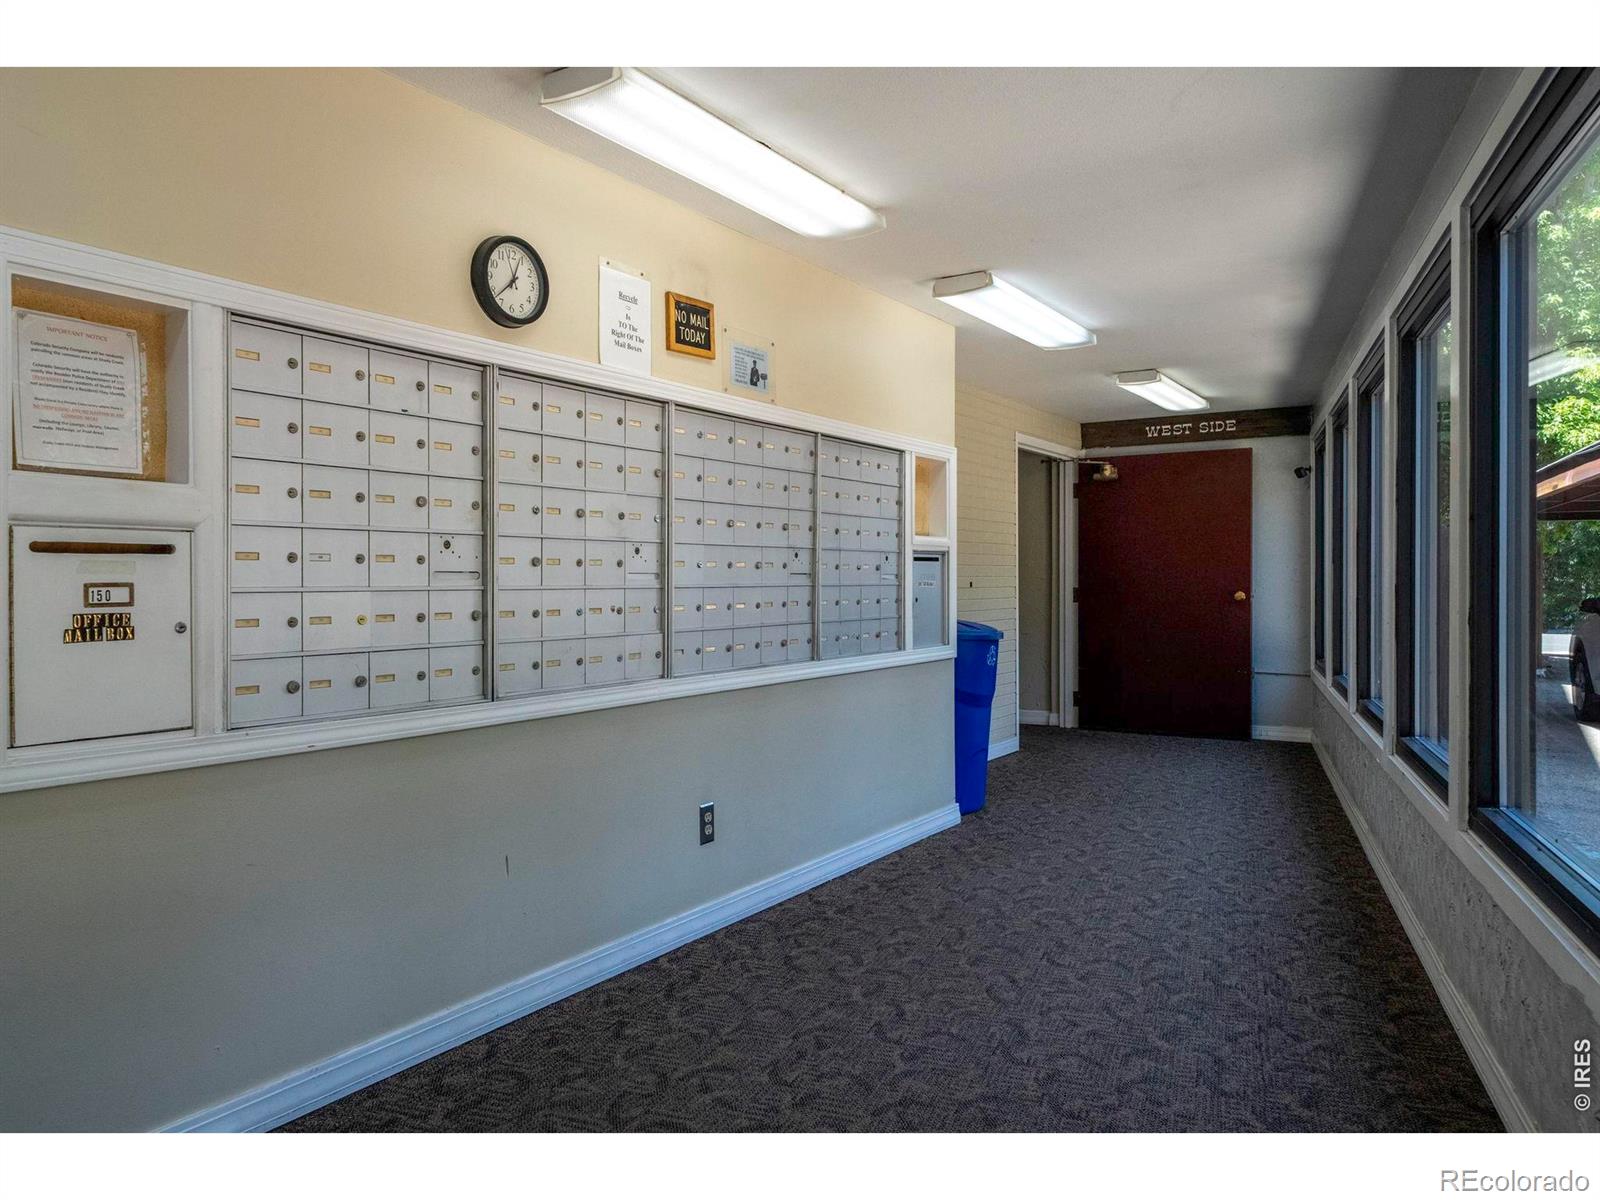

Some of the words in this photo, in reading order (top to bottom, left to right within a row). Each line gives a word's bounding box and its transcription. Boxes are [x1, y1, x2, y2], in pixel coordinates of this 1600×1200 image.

[497, 249, 504, 261] 11
[490, 259, 498, 269] 10
[527, 268, 532, 278] 2
[530, 282, 535, 292] 3
[499, 298, 504, 307] 7
[526, 295, 532, 304] 4
[508, 304, 515, 313] 6
[519, 303, 525, 313] 5
[675, 309, 687, 324] NO
[689, 312, 709, 330] MAIL
[619, 320, 628, 330] TO
[628, 323, 639, 333] The
[46, 326, 84, 337] IMPORTANT
[86, 334, 108, 342] NOTICE
[611, 328, 626, 339] Right
[634, 335, 645, 344] The
[679, 326, 706, 345] TODAY
[614, 339, 627, 349] Mail
[1145, 423, 1193, 438] WEST
[1199, 419, 1237, 433] SIDE
[91, 590, 111, 602] 150
[73, 613, 131, 628] OFFICE
[64, 629, 103, 643] MAIL
[106, 627, 134, 640] BOX
